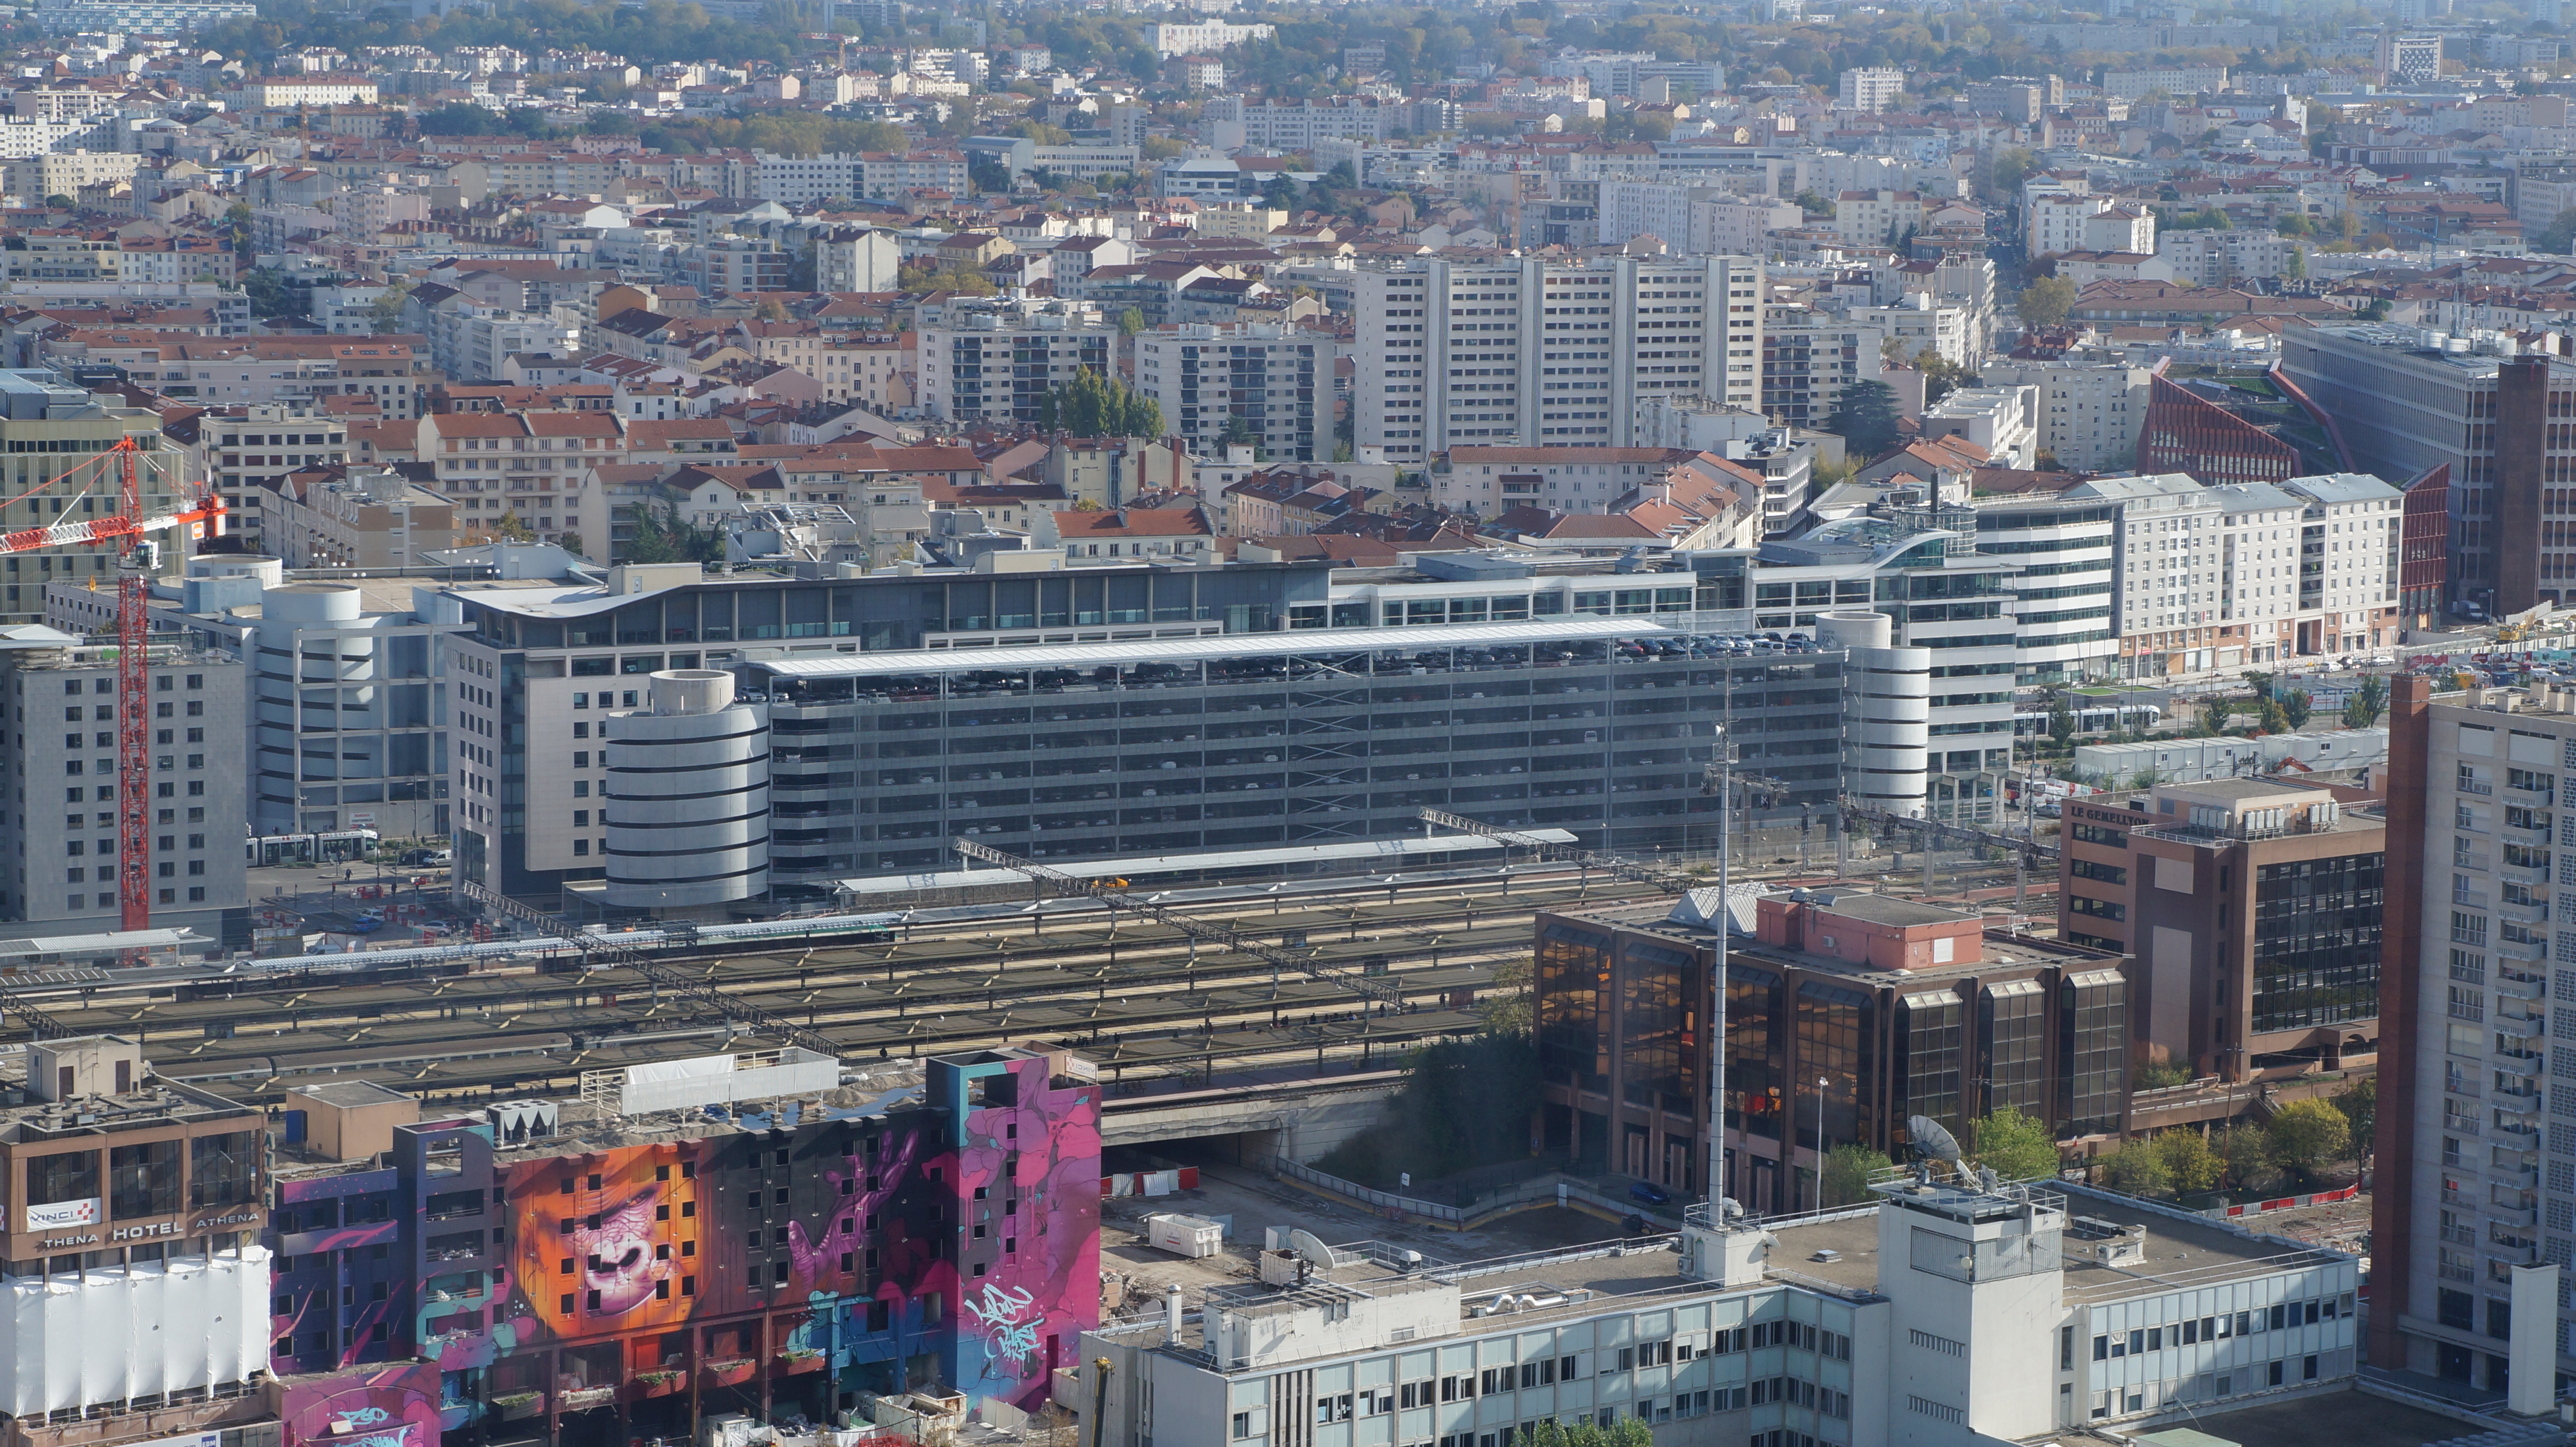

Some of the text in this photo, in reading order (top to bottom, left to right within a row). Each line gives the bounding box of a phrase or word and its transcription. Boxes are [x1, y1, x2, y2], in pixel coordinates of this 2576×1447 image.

[2071, 806, 2149, 827] LE GEMELLYON
[30, 1211, 73, 1222] VINCI
[113, 1222, 184, 1240] HOTEL
[196, 1213, 259, 1228] ATHENA
